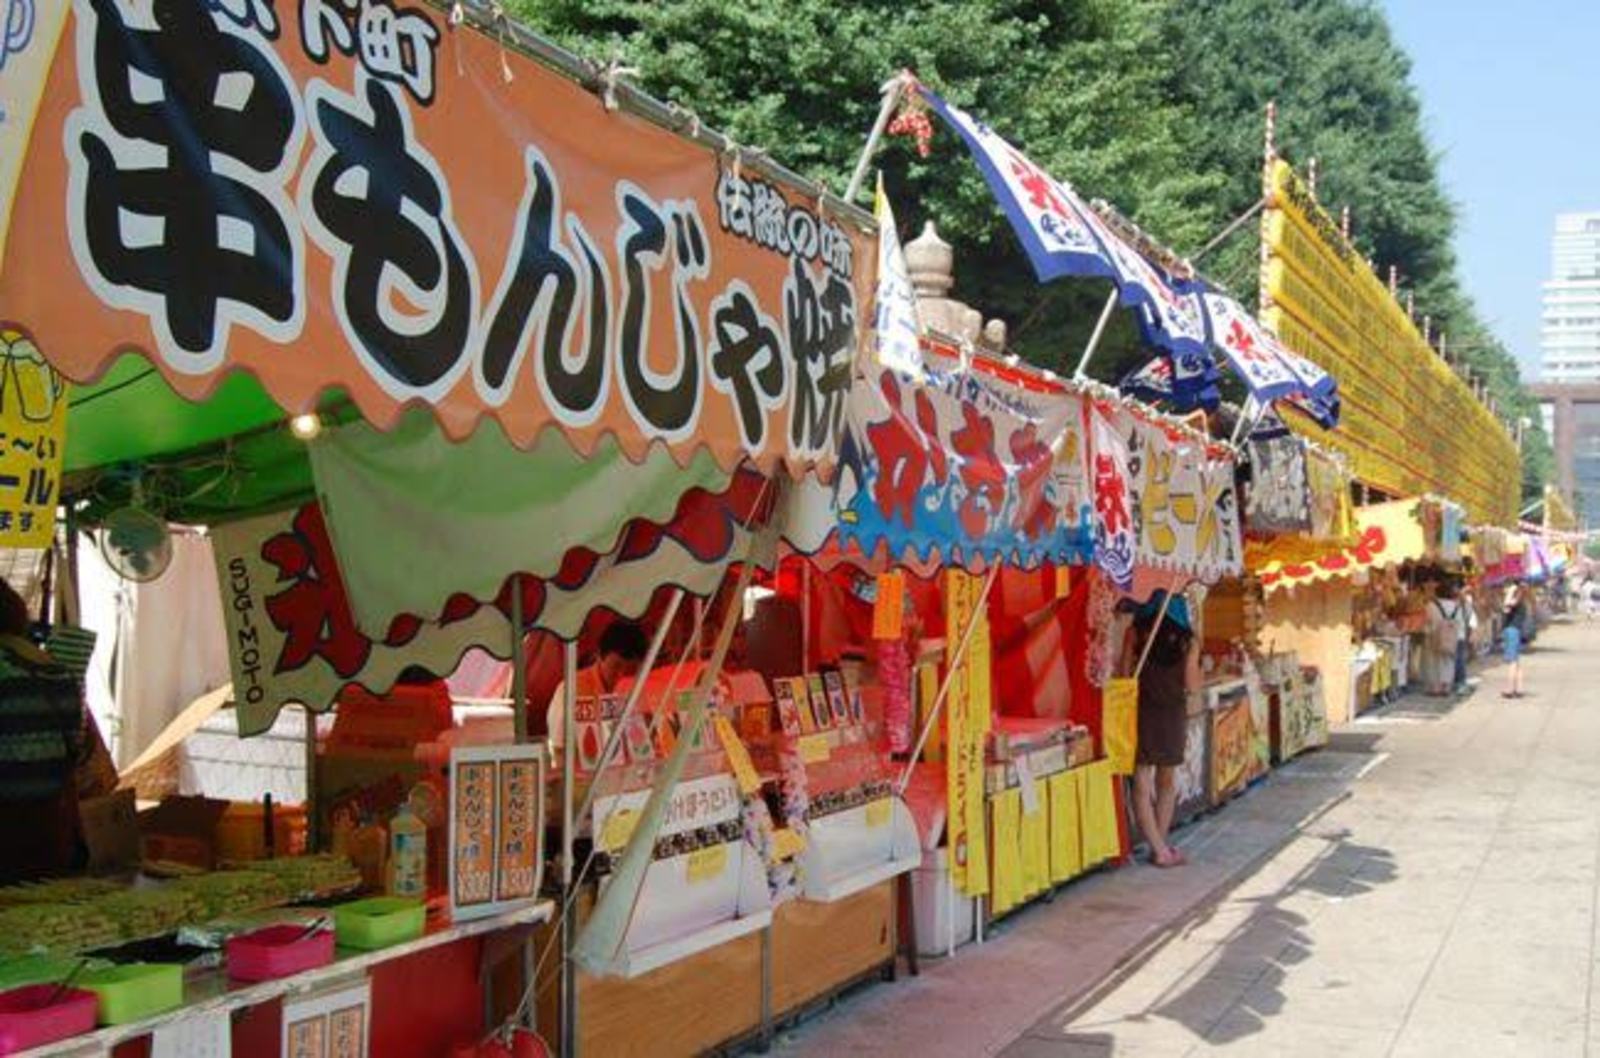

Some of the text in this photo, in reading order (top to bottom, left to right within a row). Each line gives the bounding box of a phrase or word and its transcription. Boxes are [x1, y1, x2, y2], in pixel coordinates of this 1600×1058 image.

[715, 166, 854, 278] 伝統の味
[227, 557, 265, 706] SUGIMOTO
